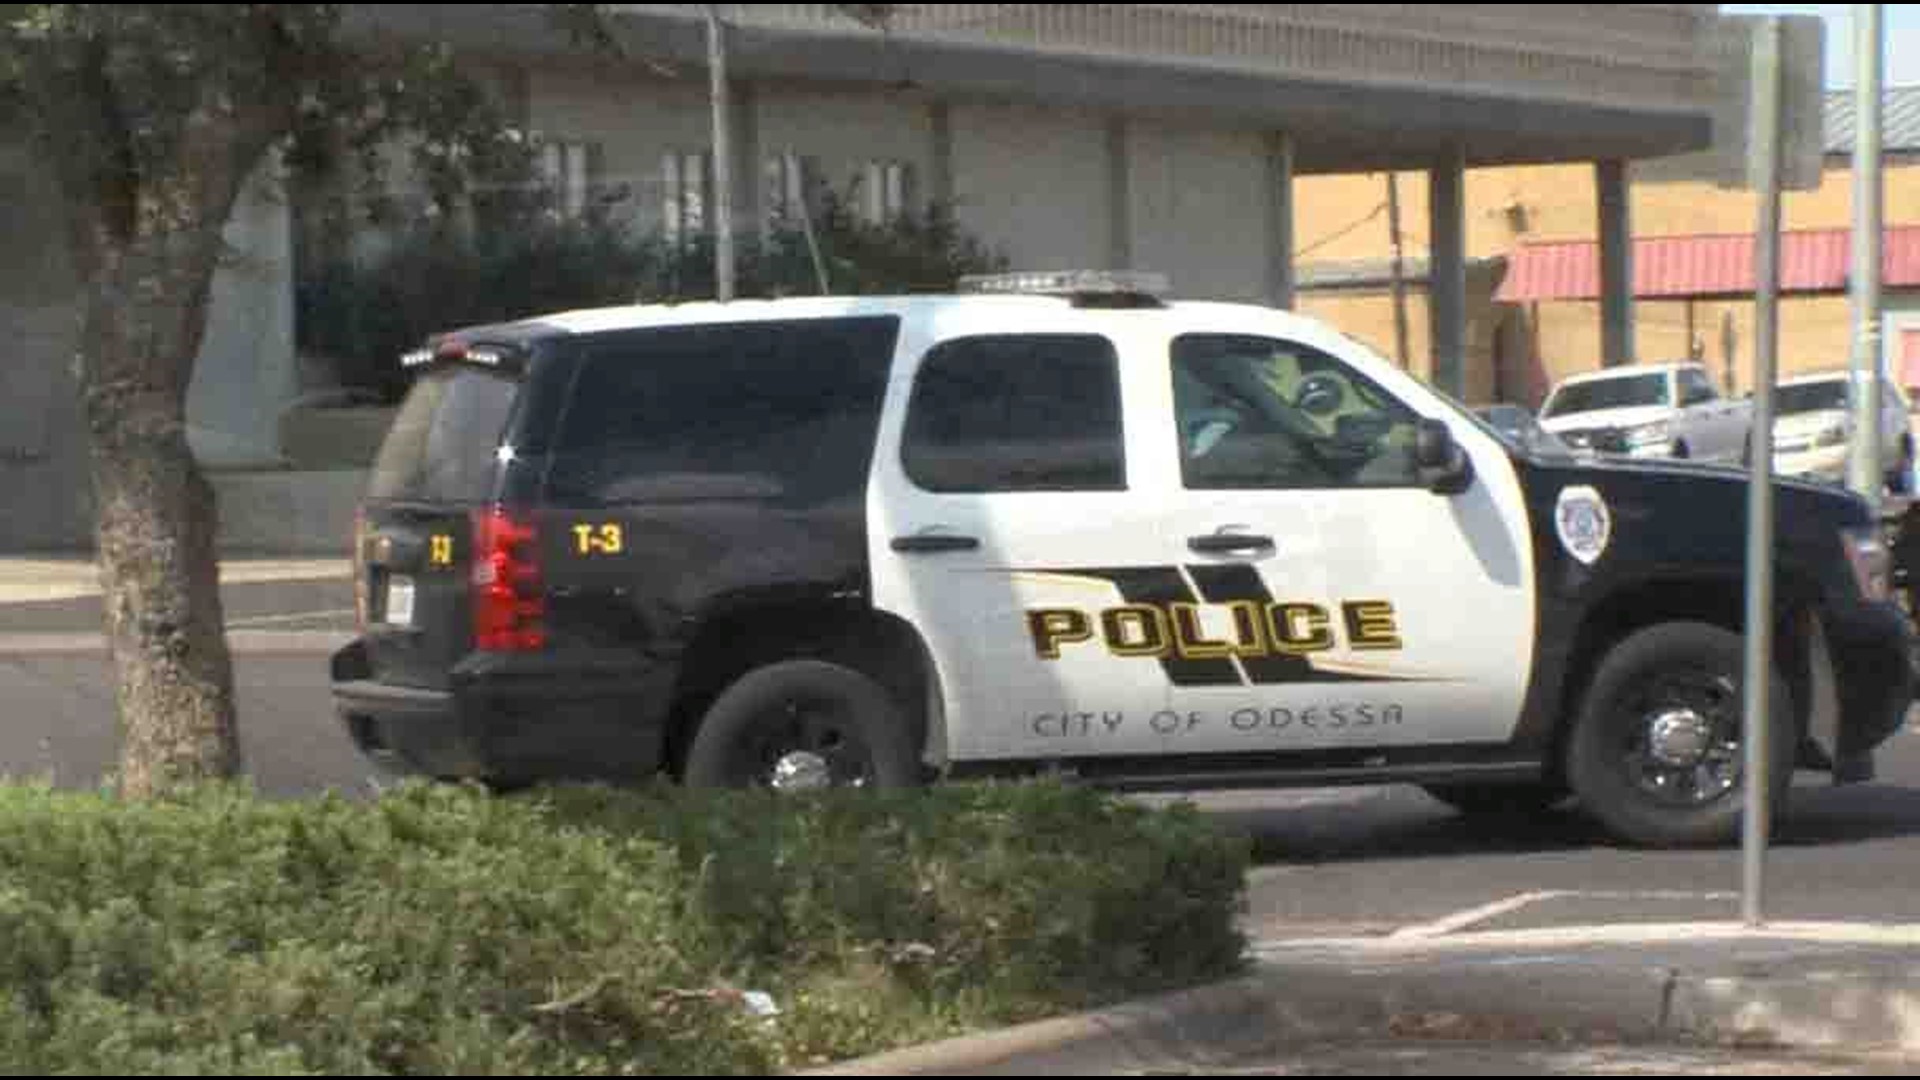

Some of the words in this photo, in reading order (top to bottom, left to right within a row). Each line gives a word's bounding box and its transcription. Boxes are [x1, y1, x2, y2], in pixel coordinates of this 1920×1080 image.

[572, 524, 622, 552] T-3
[1026, 599, 1403, 659] POLICE
[1032, 709, 1124, 737] CITY
[1150, 709, 1205, 735] OF
[1229, 704, 1403, 733] ODESSA
